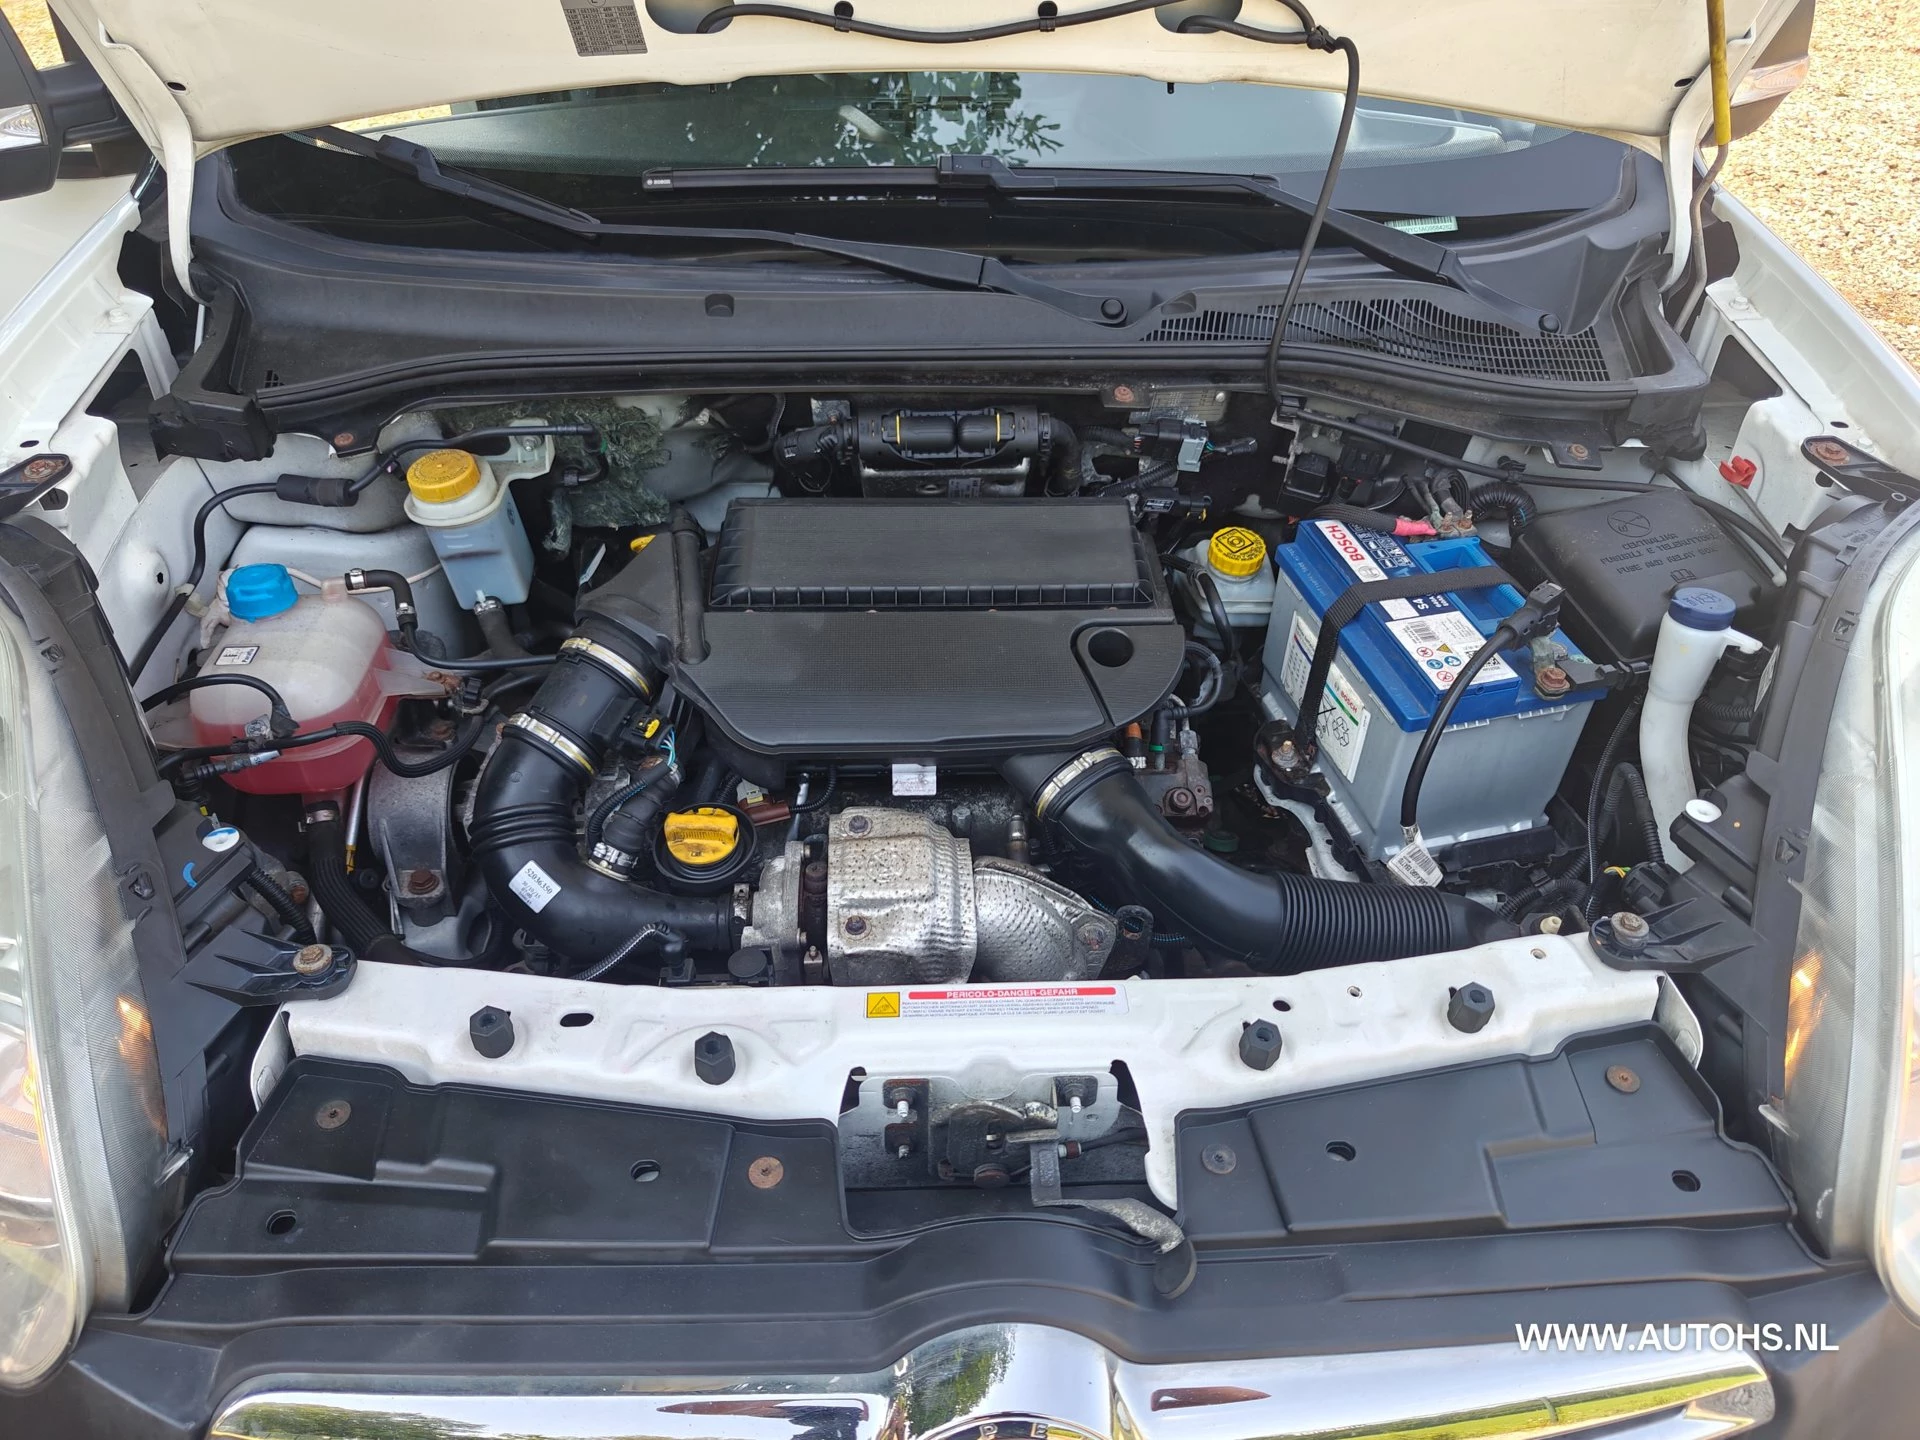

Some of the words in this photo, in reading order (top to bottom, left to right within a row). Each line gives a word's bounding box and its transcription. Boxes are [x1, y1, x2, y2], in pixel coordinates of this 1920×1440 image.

[1325, 524, 1366, 562] BOSCH
[1616, 563, 1643, 574] FUSE
[1412, 598, 1430, 610] S4
[1340, 689, 1359, 714] BOSCH
[946, 987, 1078, 999] PERICOLO-DANGER-GEFAHR
